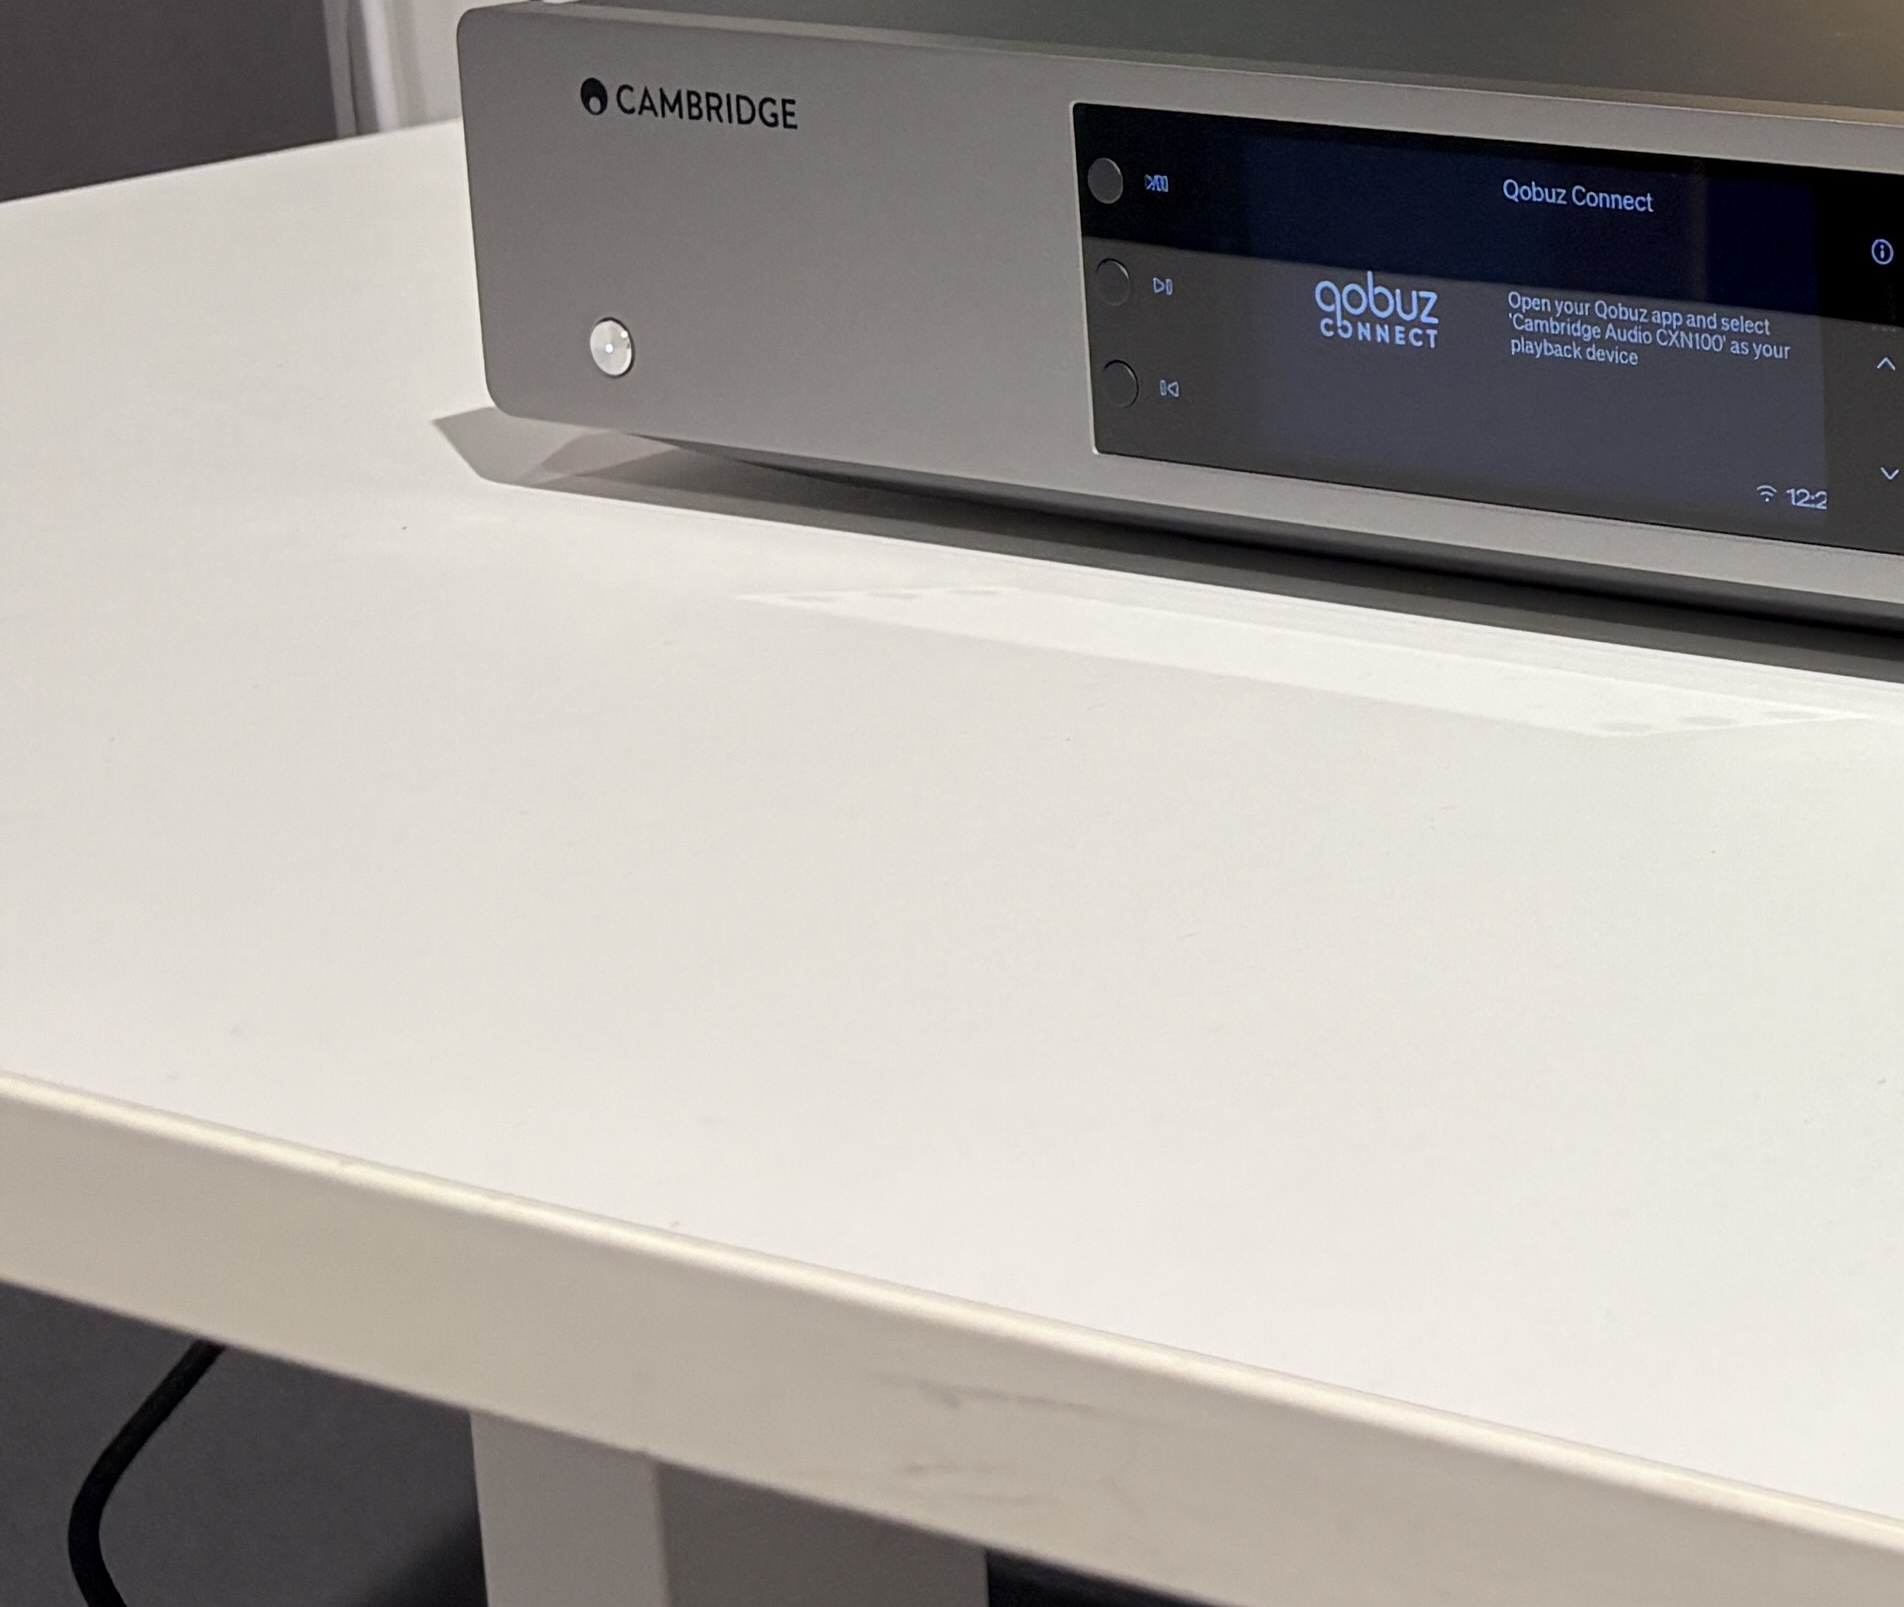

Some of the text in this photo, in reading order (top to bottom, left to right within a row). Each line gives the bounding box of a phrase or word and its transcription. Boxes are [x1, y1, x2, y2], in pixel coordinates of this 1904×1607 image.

[616, 84, 799, 130] CAMBRIDGE
[1503, 179, 1654, 212] Qobuz Connect
[1315, 270, 1439, 328] qobuz
[1508, 291, 1771, 336] Open your Qobuz app and select
[1320, 317, 1438, 349] CONNECT
[1511, 335, 1638, 367] playback device
[1605, 325, 1652, 345] Audio
[1730, 338, 1749, 355] as
[1753, 342, 1791, 361] your
